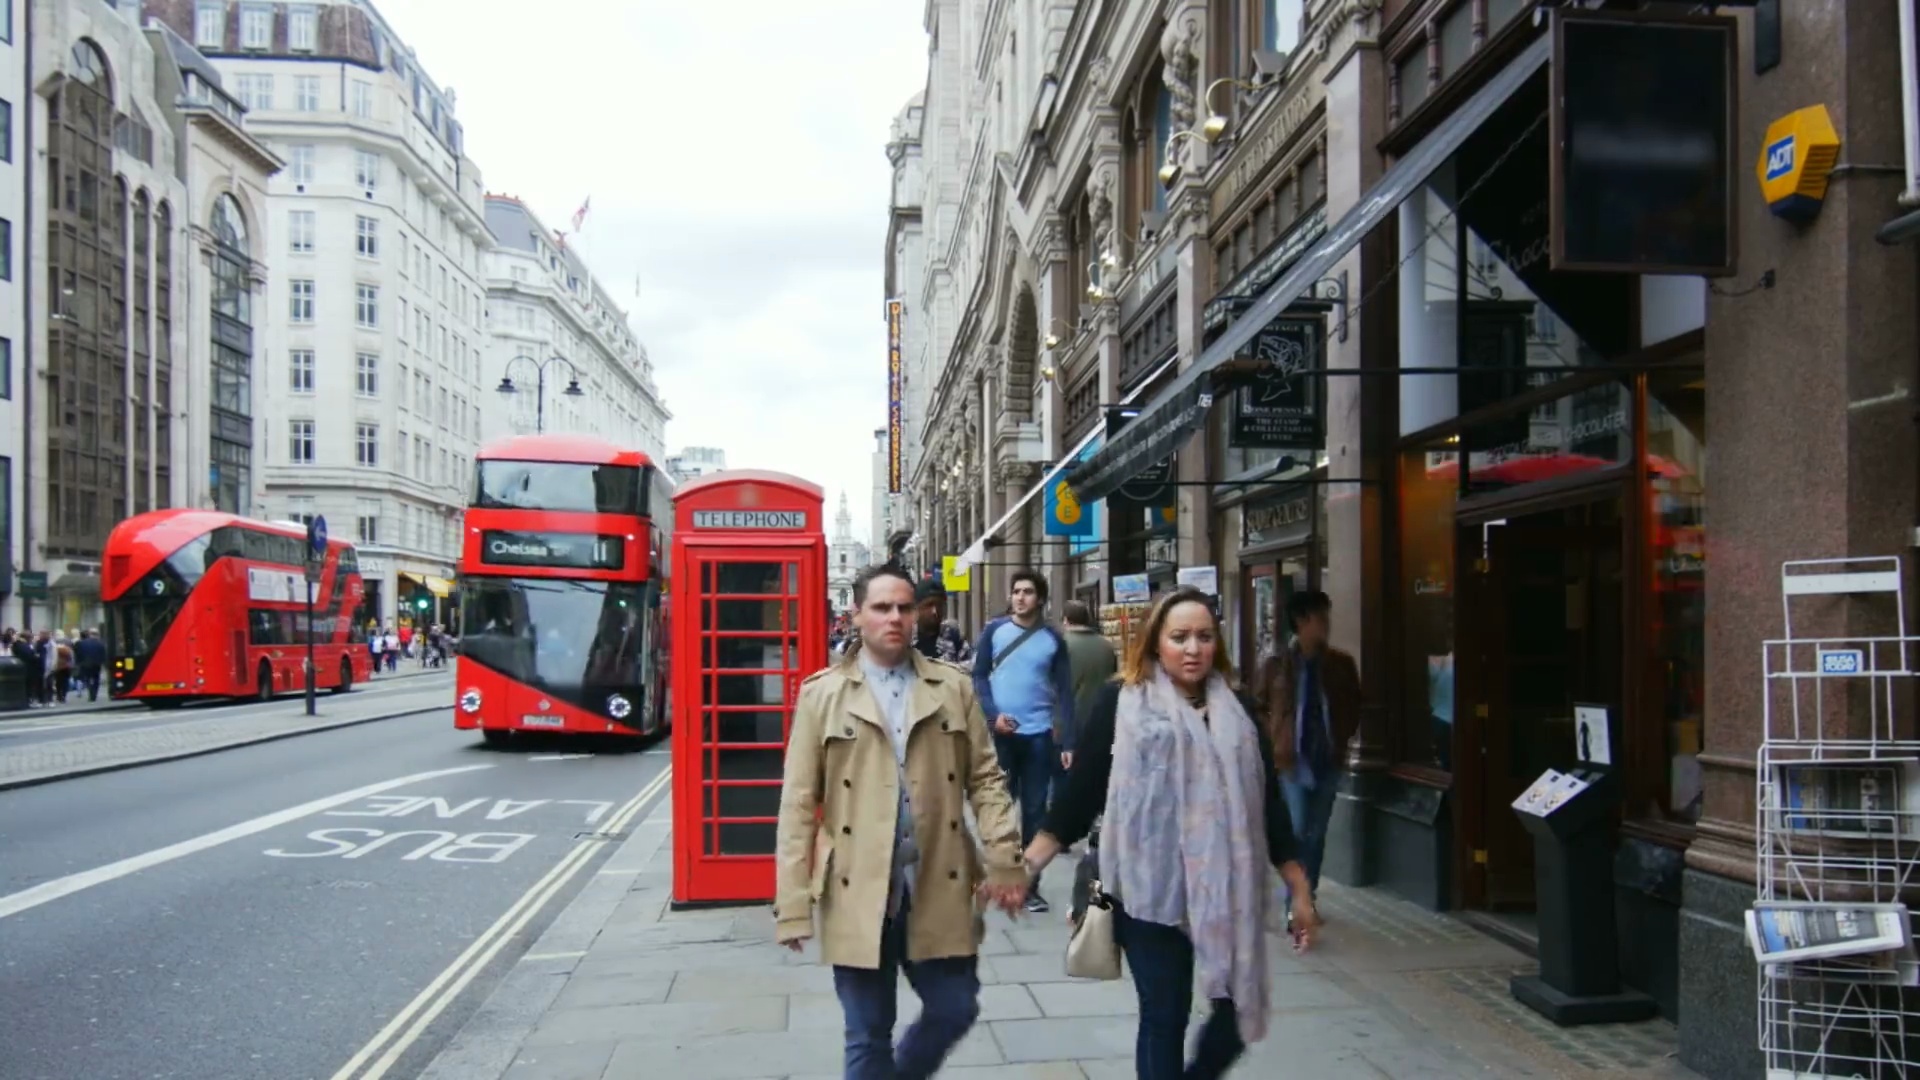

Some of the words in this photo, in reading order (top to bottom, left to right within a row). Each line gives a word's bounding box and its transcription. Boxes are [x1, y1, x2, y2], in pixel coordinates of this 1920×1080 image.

[1767, 143, 1795, 173] ADT
[696, 511, 803, 528] TELEPHONE
[490, 540, 548, 557] Chelsea
[592, 542, 608, 563] 11
[153, 579, 165, 595] 9
[1825, 663, 1855, 671] TODAY
[321, 795, 616, 825] LANE
[261, 828, 539, 864] BUS
